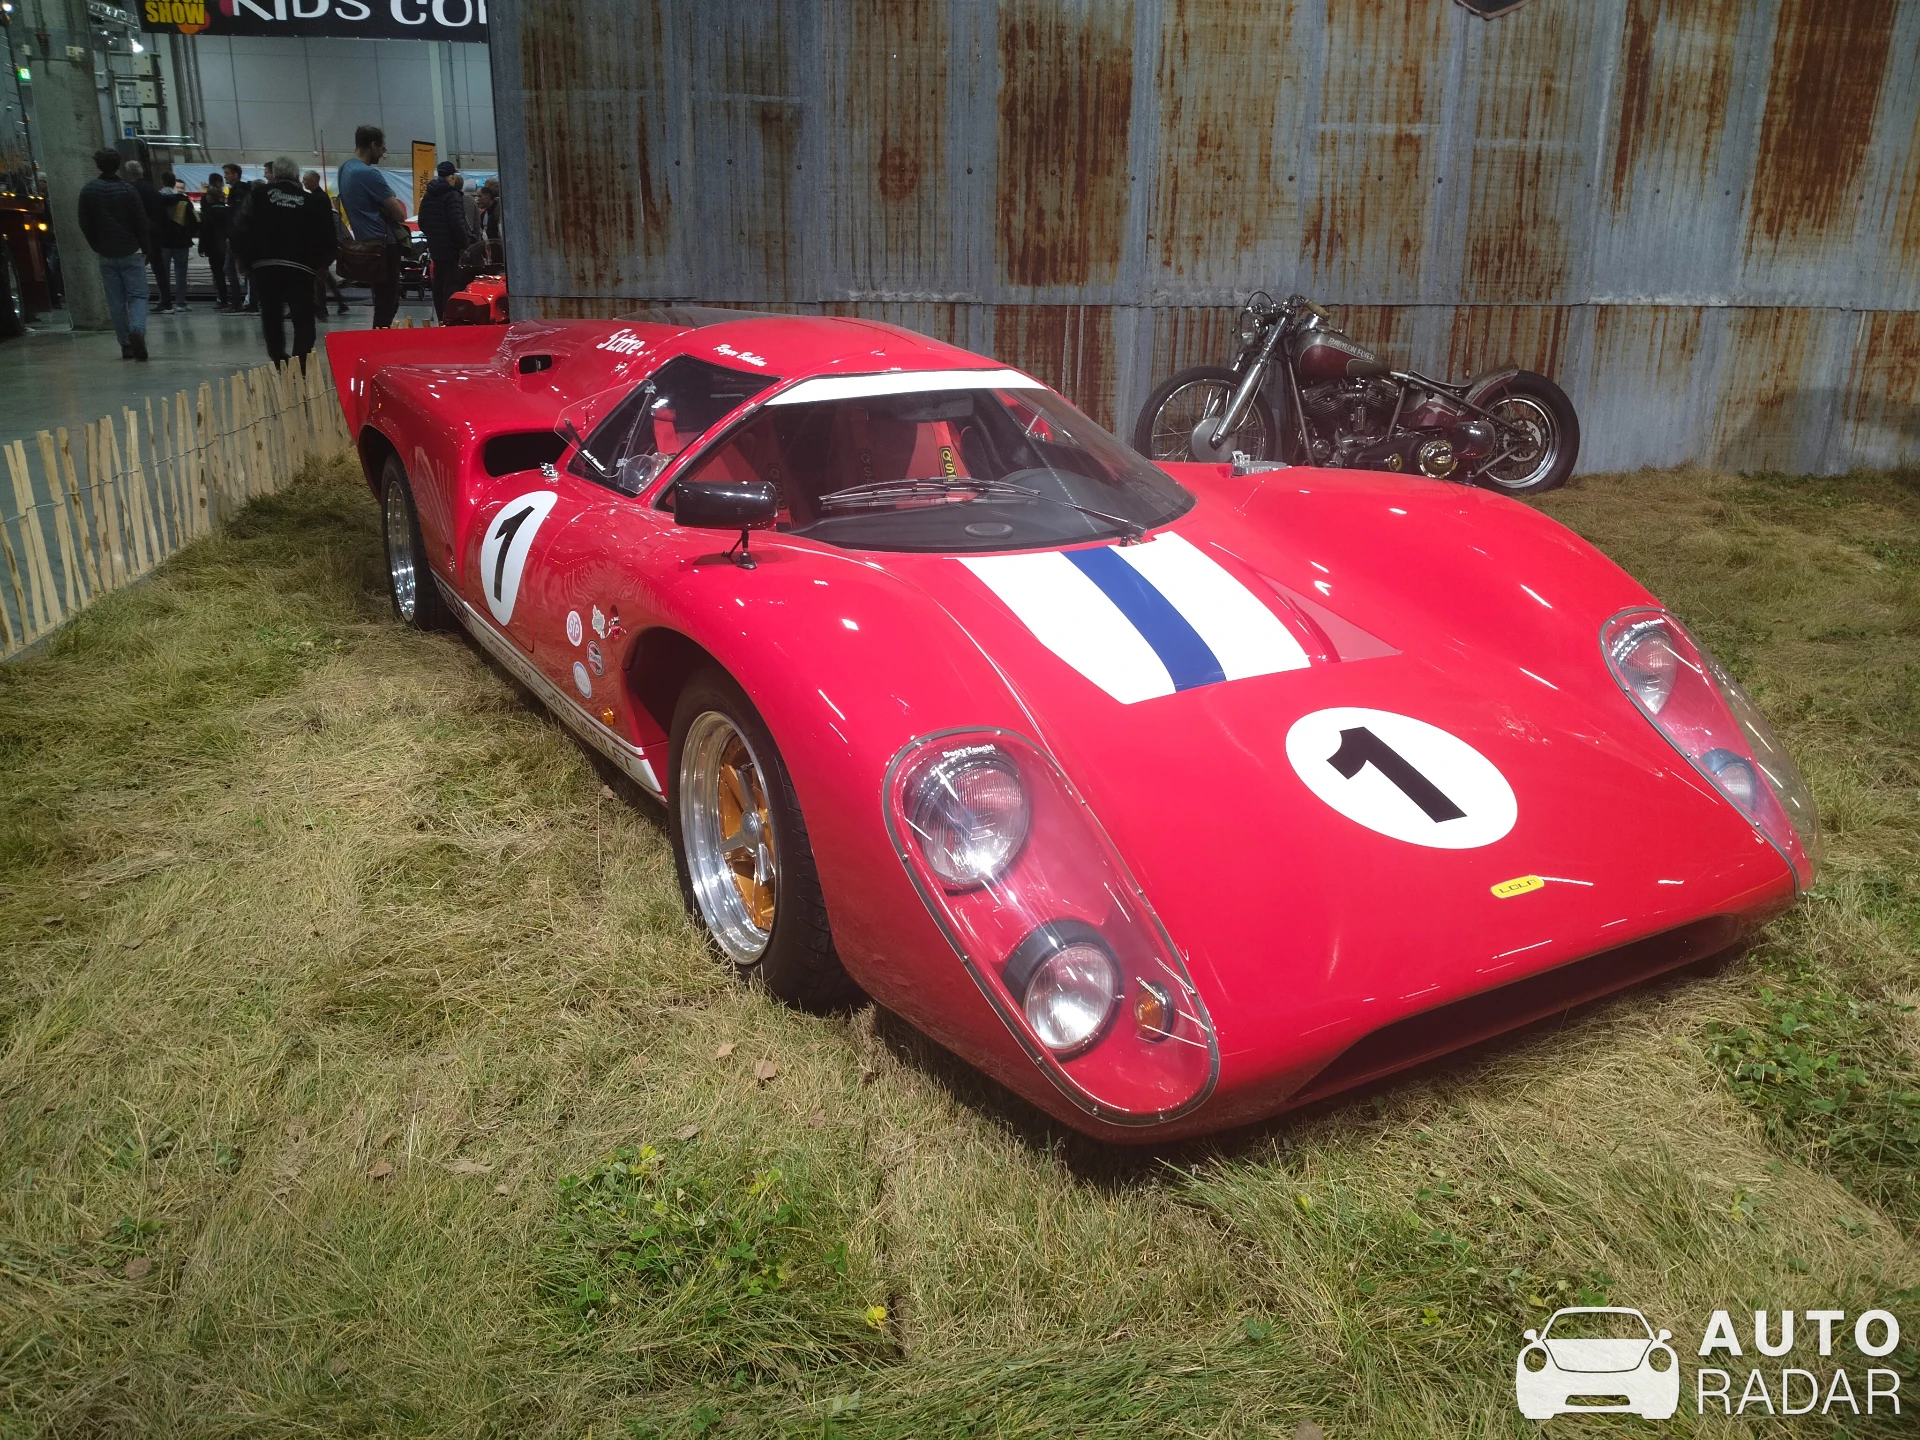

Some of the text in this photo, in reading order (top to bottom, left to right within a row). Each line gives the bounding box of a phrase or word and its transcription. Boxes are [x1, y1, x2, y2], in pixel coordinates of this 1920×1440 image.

[145, 2, 204, 24] SHOW
[494, 505, 535, 603] 1
[568, 616, 580, 638] STP
[1326, 726, 1468, 823] 1
[1498, 879, 1538, 894] LOLA
